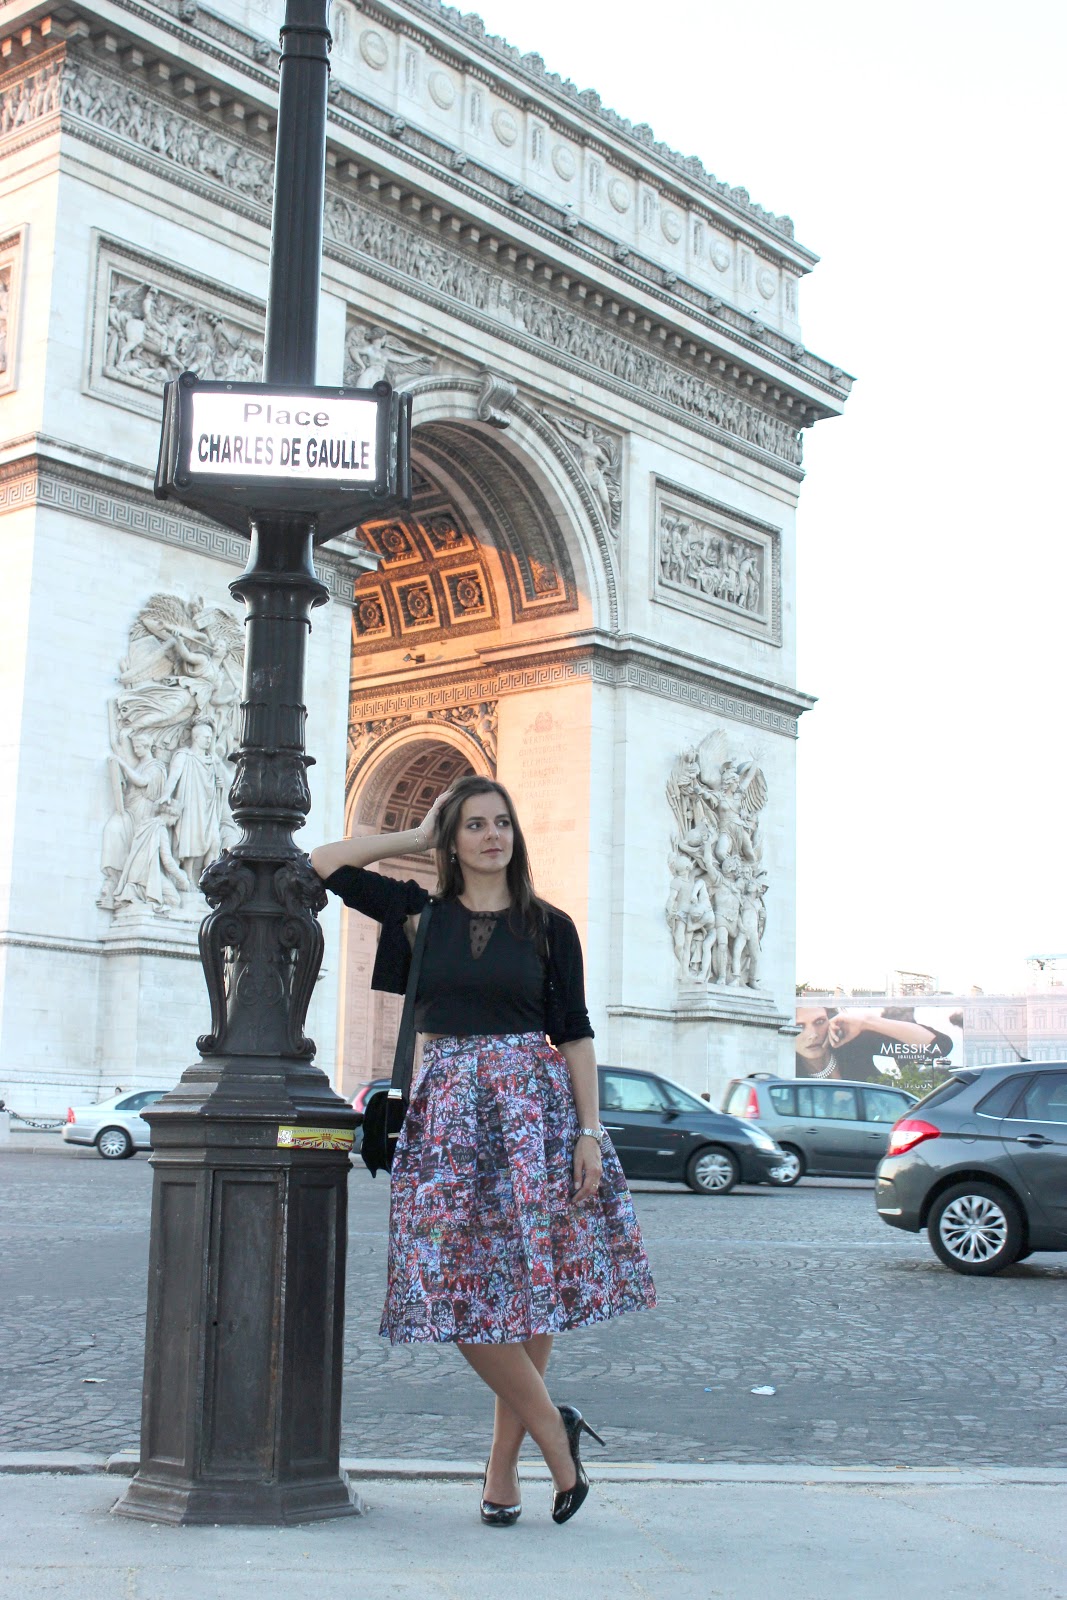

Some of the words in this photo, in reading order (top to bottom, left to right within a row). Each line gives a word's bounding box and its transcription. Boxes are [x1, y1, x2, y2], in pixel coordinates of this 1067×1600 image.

[243, 403, 330, 427] Place
[198, 433, 274, 465] CHARLES
[280, 437, 302, 467] DE
[306, 438, 370, 469] GAULLE
[880, 1042, 942, 1055] MESSIKA
